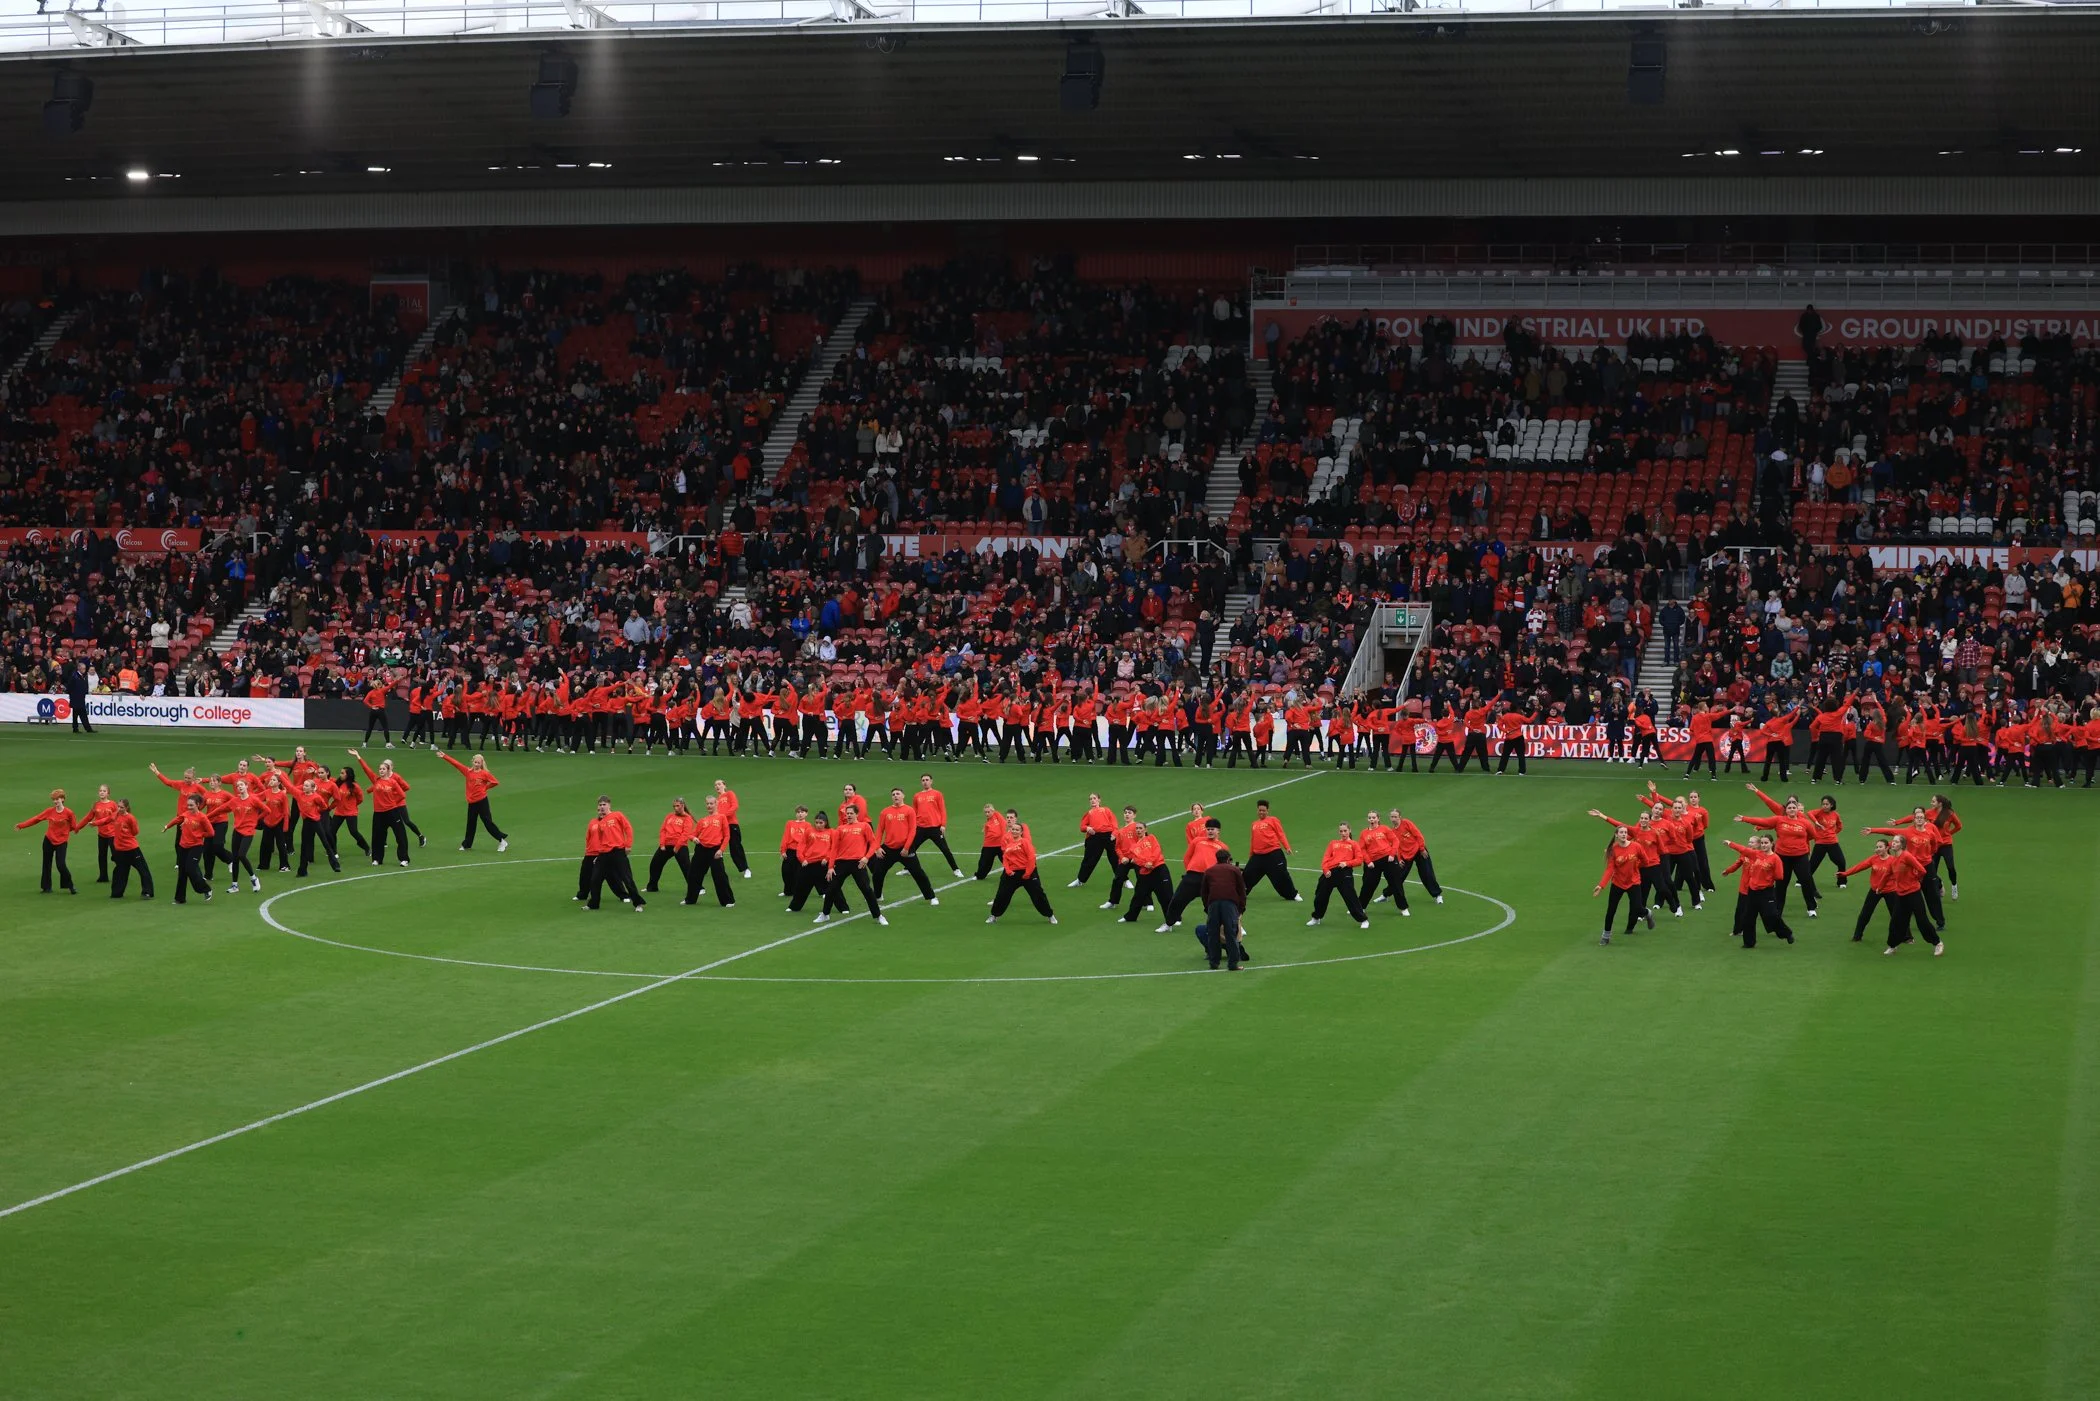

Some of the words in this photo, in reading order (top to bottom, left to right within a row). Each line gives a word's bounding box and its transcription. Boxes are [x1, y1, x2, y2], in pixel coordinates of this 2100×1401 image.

[1455, 317, 1611, 338] INDSTRIAL
[1617, 317, 1652, 338] UK
[1840, 317, 1938, 339] GROUP
[41, 704, 51, 713] M
[57, 704, 65, 713] C
[86, 702, 189, 722] iddlesbrough
[193, 706, 251, 725] College
